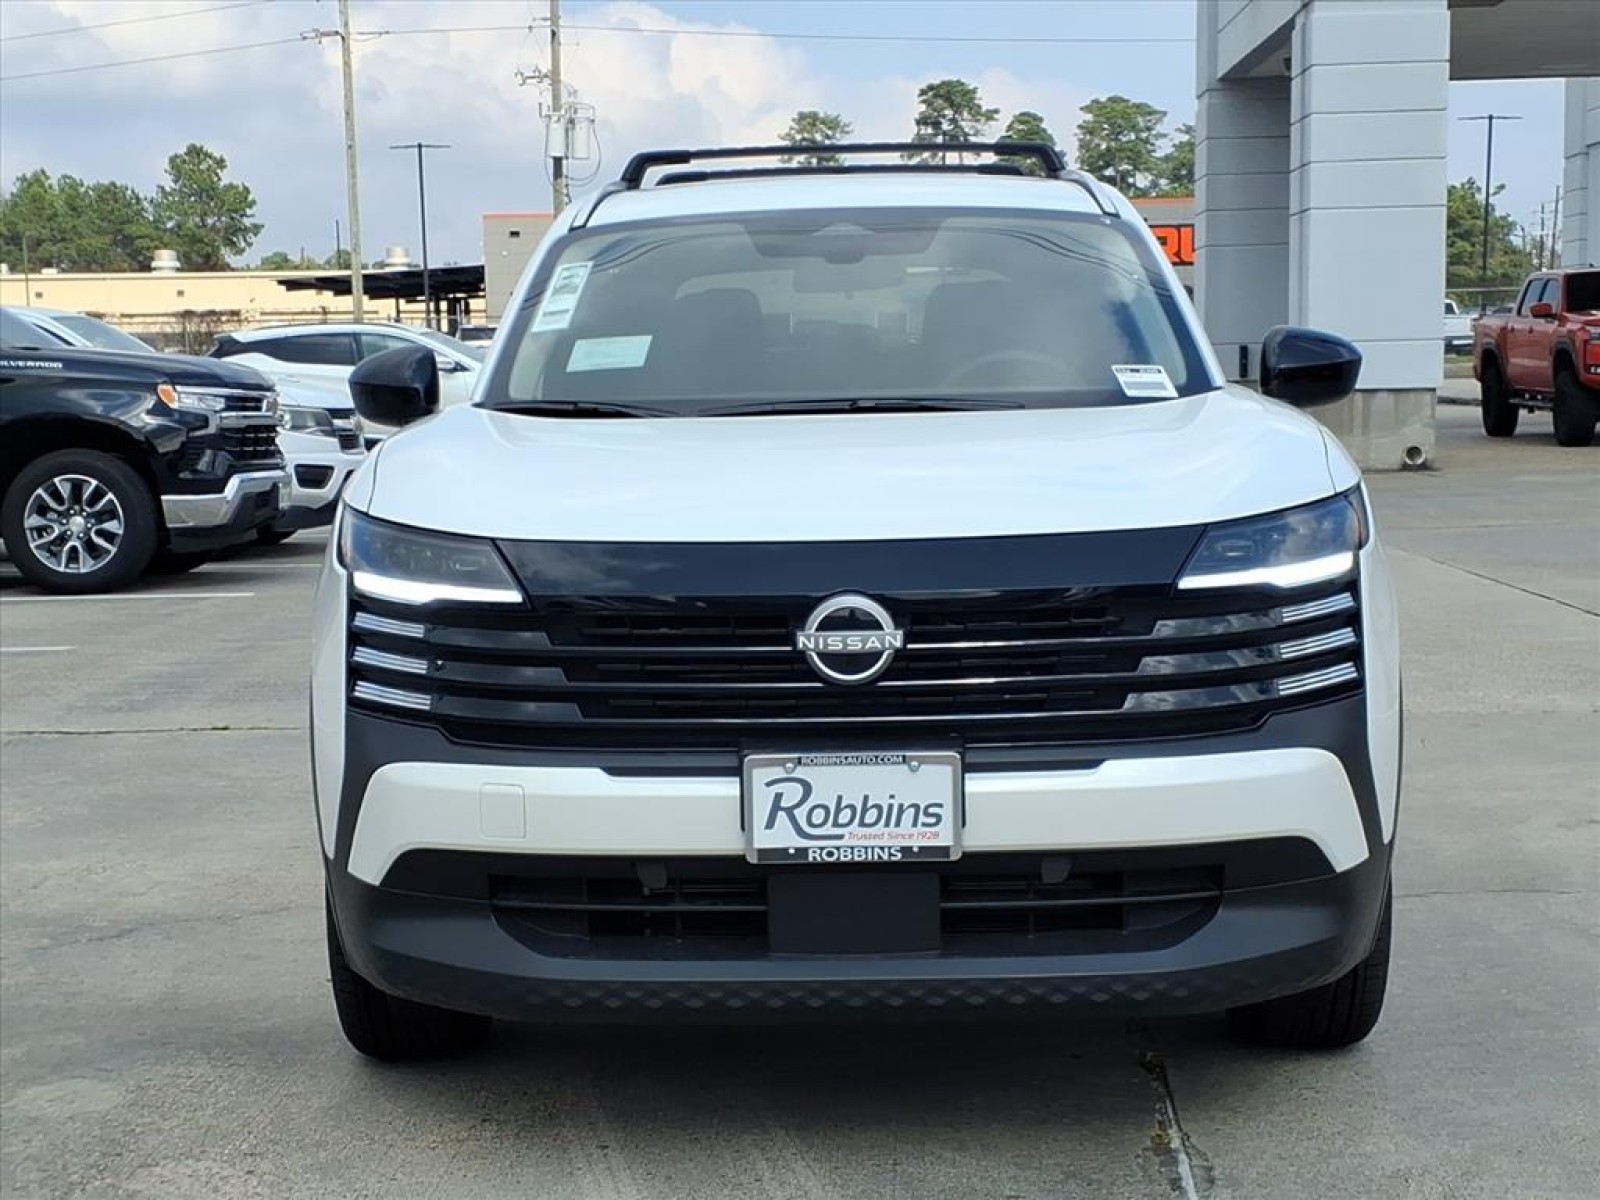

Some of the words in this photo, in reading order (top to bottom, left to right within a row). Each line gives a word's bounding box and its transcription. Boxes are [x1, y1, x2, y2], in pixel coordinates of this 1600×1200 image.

[0, 360, 63, 369] ILVERADO
[799, 635, 901, 650] NISSAN
[801, 755, 902, 765] ROBBINSAUTO.COM
[764, 776, 944, 840] Robbins
[848, 831, 885, 840] Trusted
[888, 831, 914, 840] Since
[917, 831, 940, 840] 1928
[808, 847, 902, 861] ROBBINS
